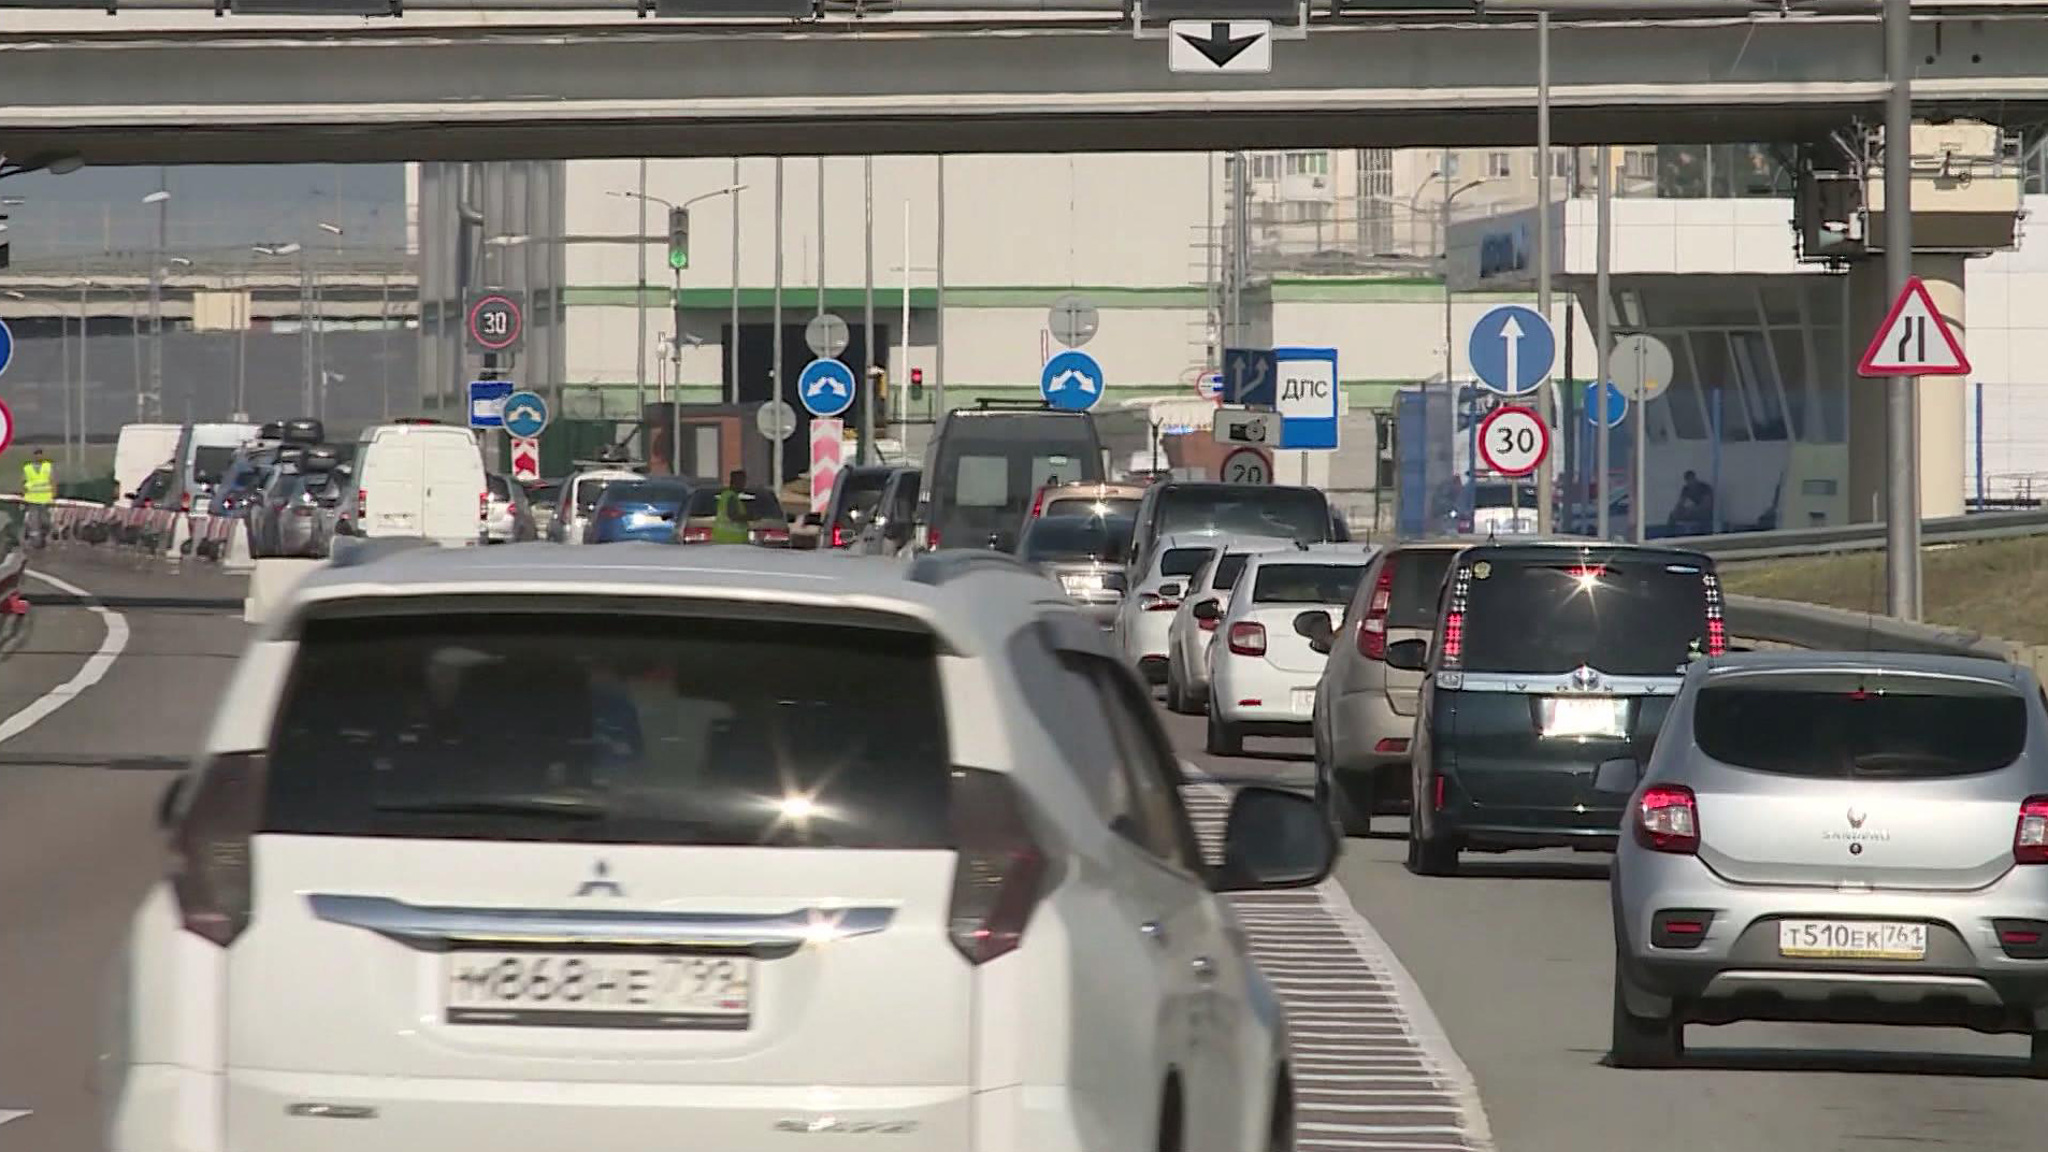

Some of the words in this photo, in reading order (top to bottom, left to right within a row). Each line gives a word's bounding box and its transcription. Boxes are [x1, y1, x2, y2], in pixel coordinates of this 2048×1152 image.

[483, 312, 507, 334] 30
[1282, 379, 1328, 400] ДПС
[1496, 427, 1534, 454] 30
